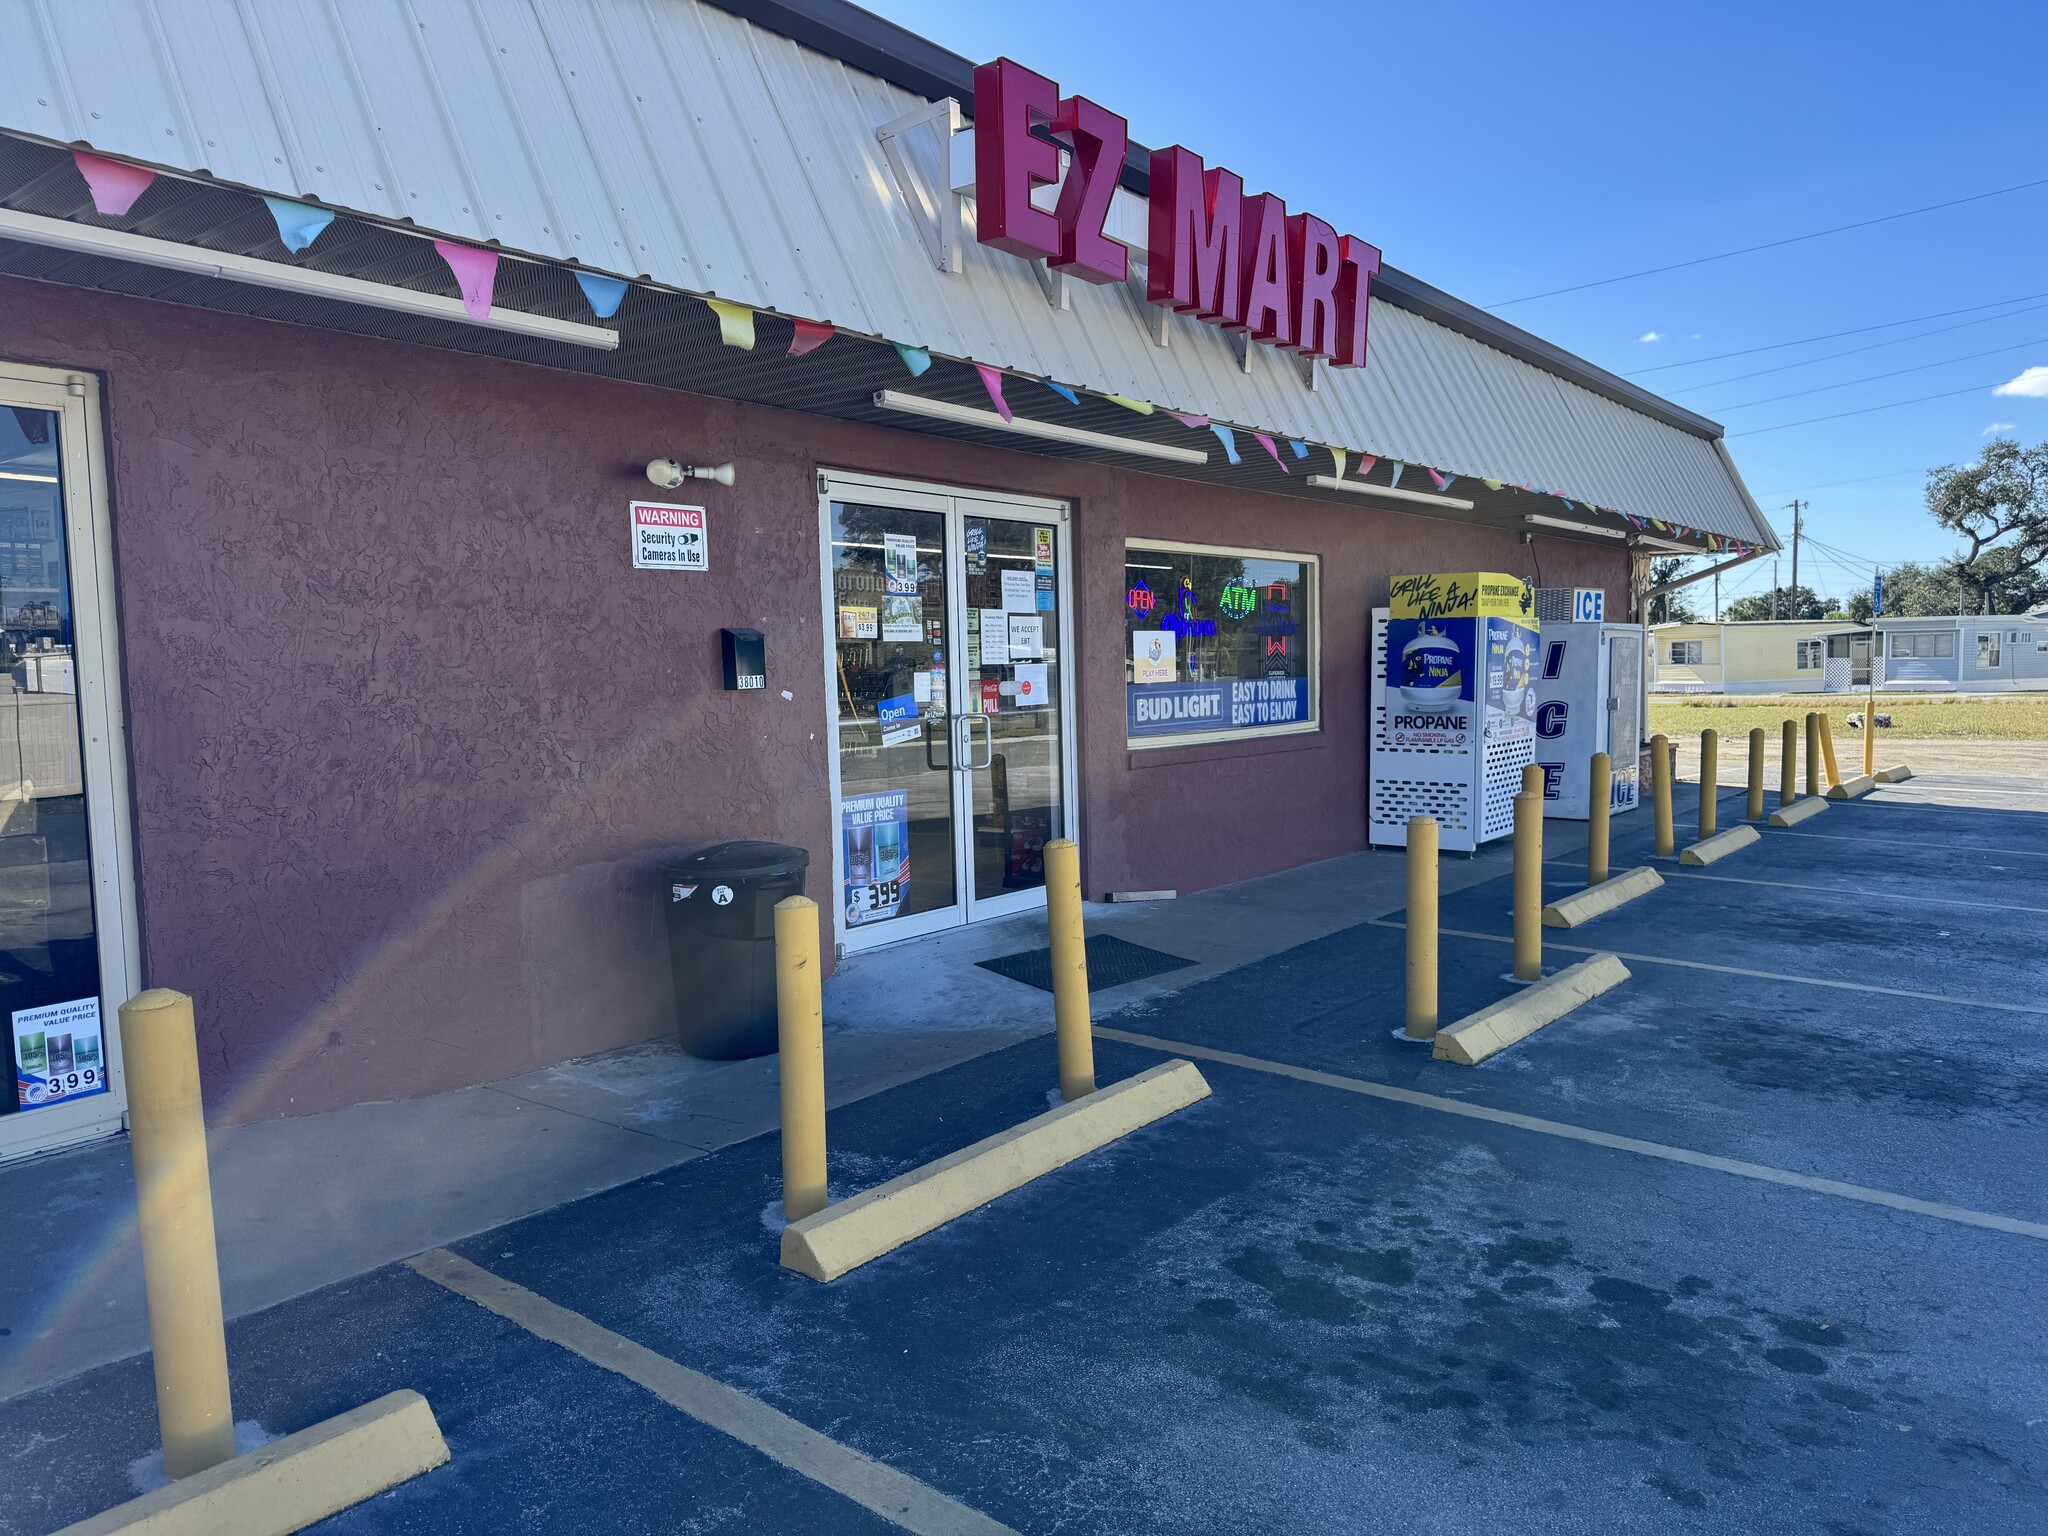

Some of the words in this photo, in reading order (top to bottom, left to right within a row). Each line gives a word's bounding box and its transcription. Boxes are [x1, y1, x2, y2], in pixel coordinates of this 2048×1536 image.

[973, 56, 1128, 285] EZ
[1147, 144, 1381, 369] MART
[639, 509, 699, 527] WARNING
[641, 530, 676, 548] Security
[642, 547, 676, 562] Cameras
[678, 549, 686, 562] In
[687, 550, 700, 563] Use
[1390, 574, 1438, 599] GRILL
[1407, 586, 1441, 608] LIKE
[1446, 581, 1461, 597] A
[1481, 584, 1500, 596] PROPANE
[1500, 585, 1520, 597] EXCHANGE
[1129, 589, 1155, 610] OPEN
[1219, 586, 1256, 611] ATM
[1418, 588, 1478, 620] NINJA!
[1575, 591, 1603, 620] ICE
[1020, 625, 1039, 633] ACCEPT
[1021, 637, 1031, 645] EBT
[1423, 653, 1454, 666] PROPANE
[1155, 668, 1169, 677] HERE
[738, 675, 764, 689] 38010
[1232, 682, 1255, 702] EASY
[1256, 681, 1269, 701] TO
[1270, 679, 1297, 700] DRINK
[932, 691, 944, 700] PULL
[881, 706, 906, 722] Open
[983, 698, 999, 713] PULL
[1136, 696, 1173, 722] BUD
[1174, 694, 1221, 718] LIGHT
[1231, 703, 1256, 724] EASY
[1256, 702, 1269, 722] TO
[1270, 700, 1297, 720] ENJOY
[1394, 715, 1467, 730] PROPANE
[841, 799, 875, 814] PREMIUM
[875, 794, 904, 810] QUALITY
[851, 813, 873, 825] VALUE
[874, 808, 894, 822] PRICE
[718, 894, 728, 904] A
[868, 880, 901, 911] 3.99
[17, 1010, 58, 1024] PREMIUM
[60, 1002, 97, 1015] QUALITY
[43, 1016, 70, 1027] VALUE
[71, 1011, 97, 1021] PRICE
